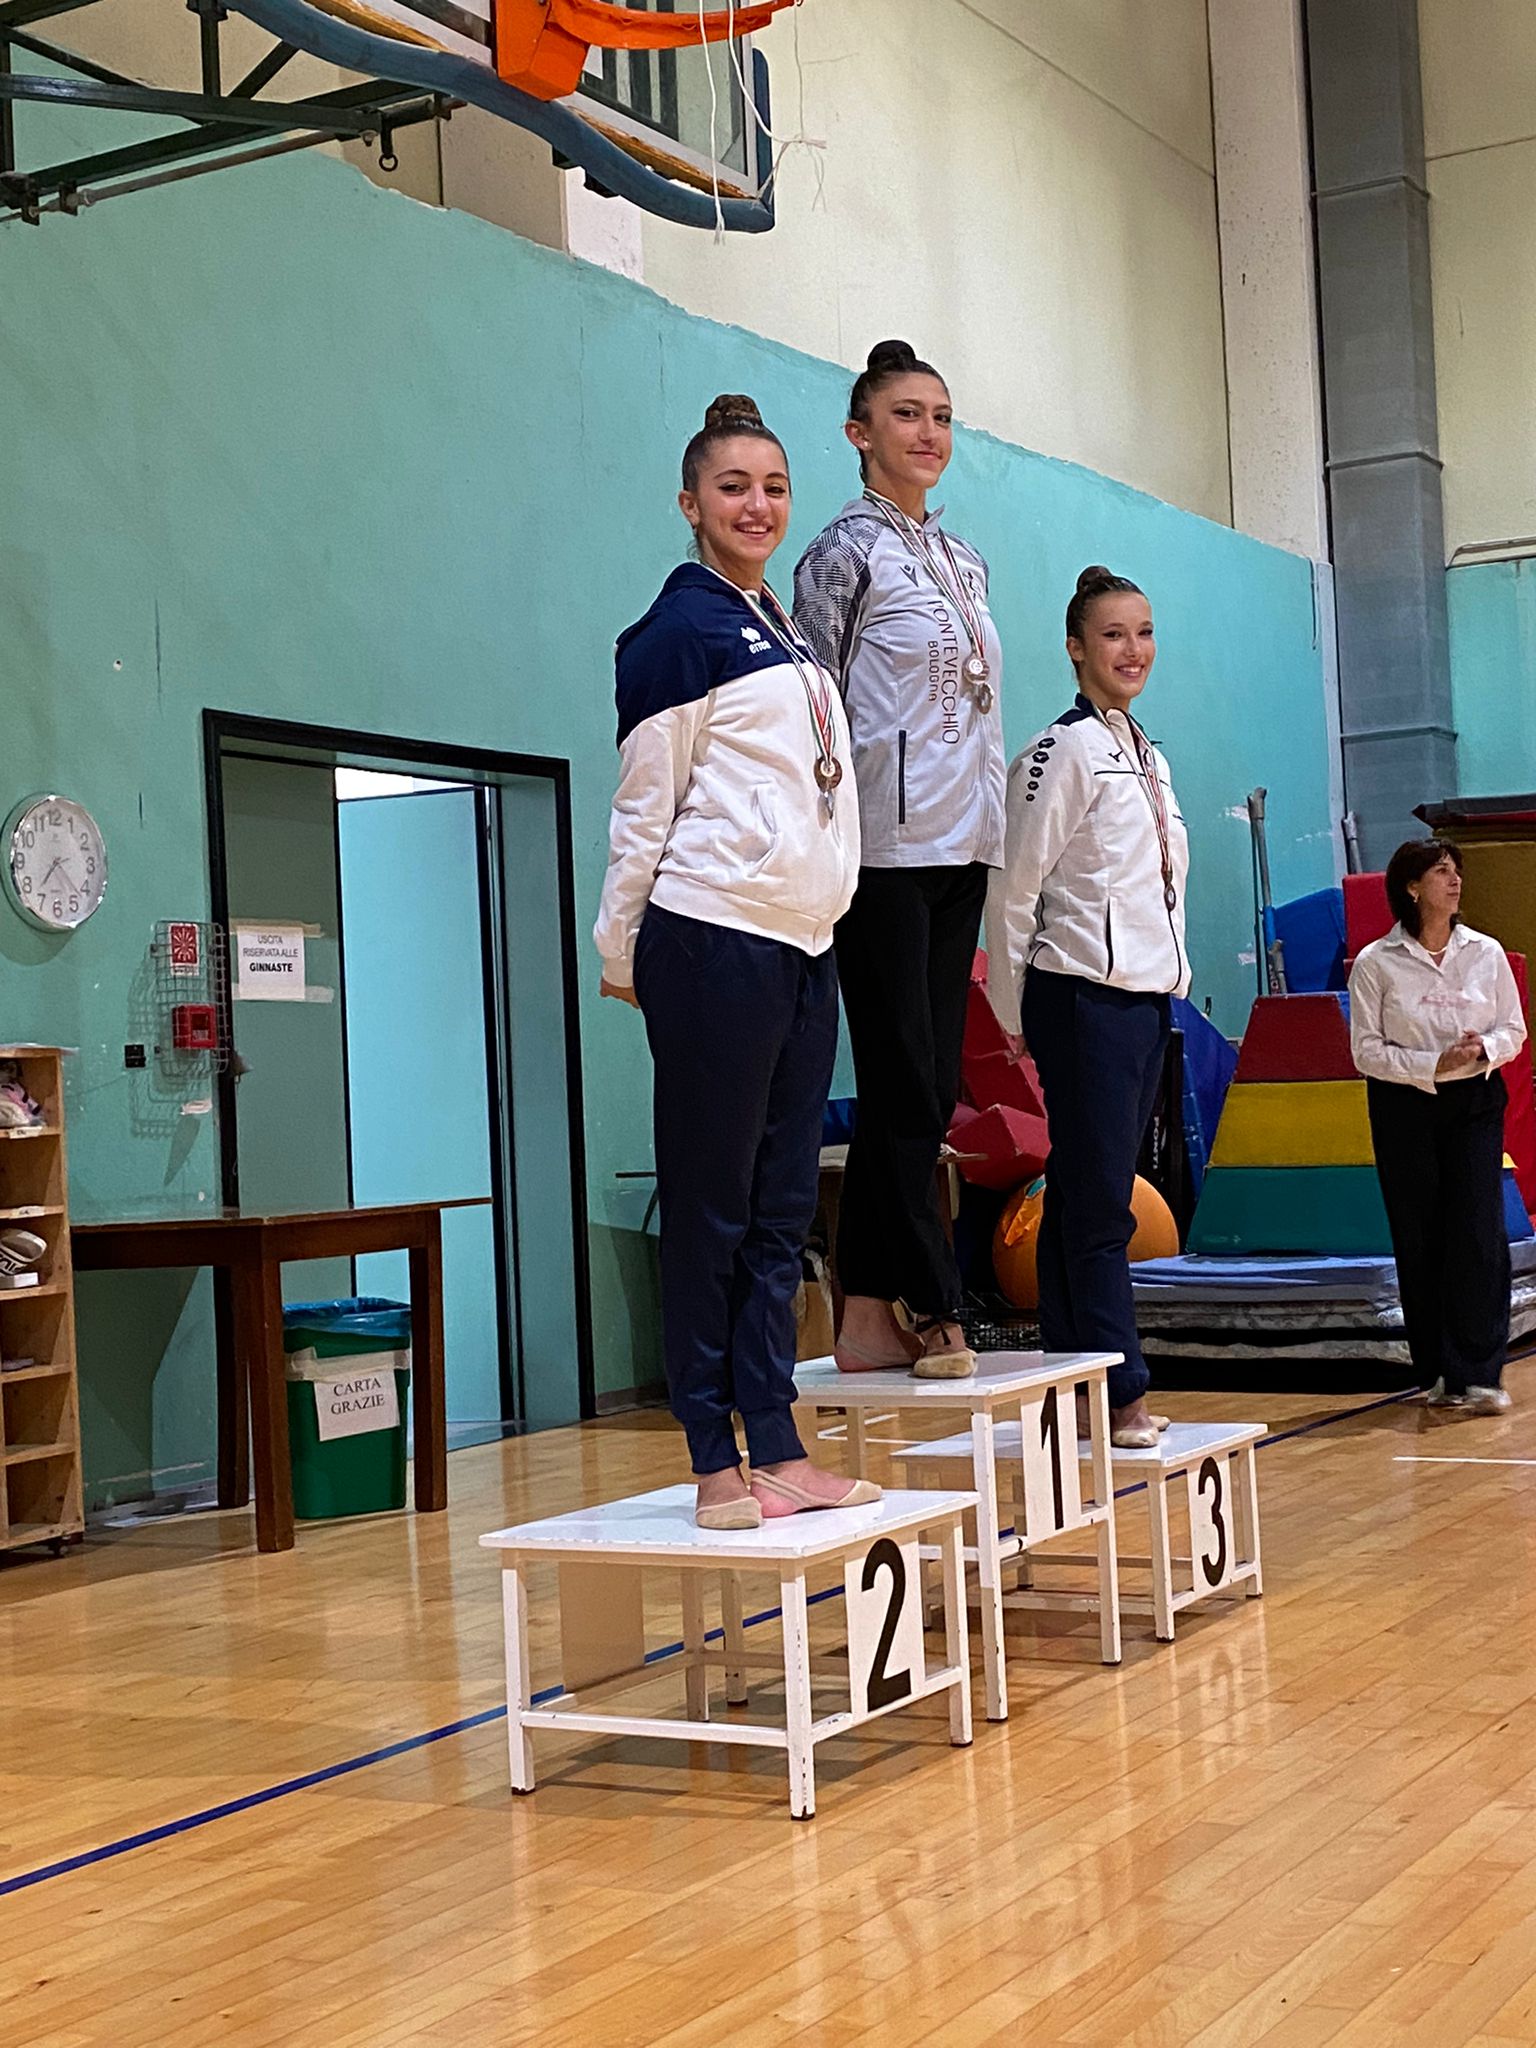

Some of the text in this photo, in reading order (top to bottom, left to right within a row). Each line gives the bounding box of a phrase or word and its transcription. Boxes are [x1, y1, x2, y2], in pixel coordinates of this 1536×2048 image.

[927, 600, 961, 744] PONTEVECCHIO
[33, 813, 45, 832] 11
[48, 808, 62, 826] 12
[67, 816, 74, 833] 1
[20, 830, 35, 848] 10
[80, 833, 90, 850] 2
[15, 852, 25, 870] 9
[86, 856, 96, 874] 3
[22, 876, 32, 894] 8
[80, 880, 90, 895] 4
[37, 894, 46, 911] 7
[53, 900, 62, 918] 6
[69, 895, 79, 912] 5
[257, 934, 283, 944] USCITA
[243, 948, 298, 957] RISERVATA ALLE
[249, 962, 293, 972] GINNASTE
[333, 1377, 382, 1397] CARTA
[330, 1394, 385, 1415] GRAZIE
[1040, 1385, 1064, 1530] 1
[1198, 1456, 1227, 1587] 3
[861, 1537, 912, 1713] 2
